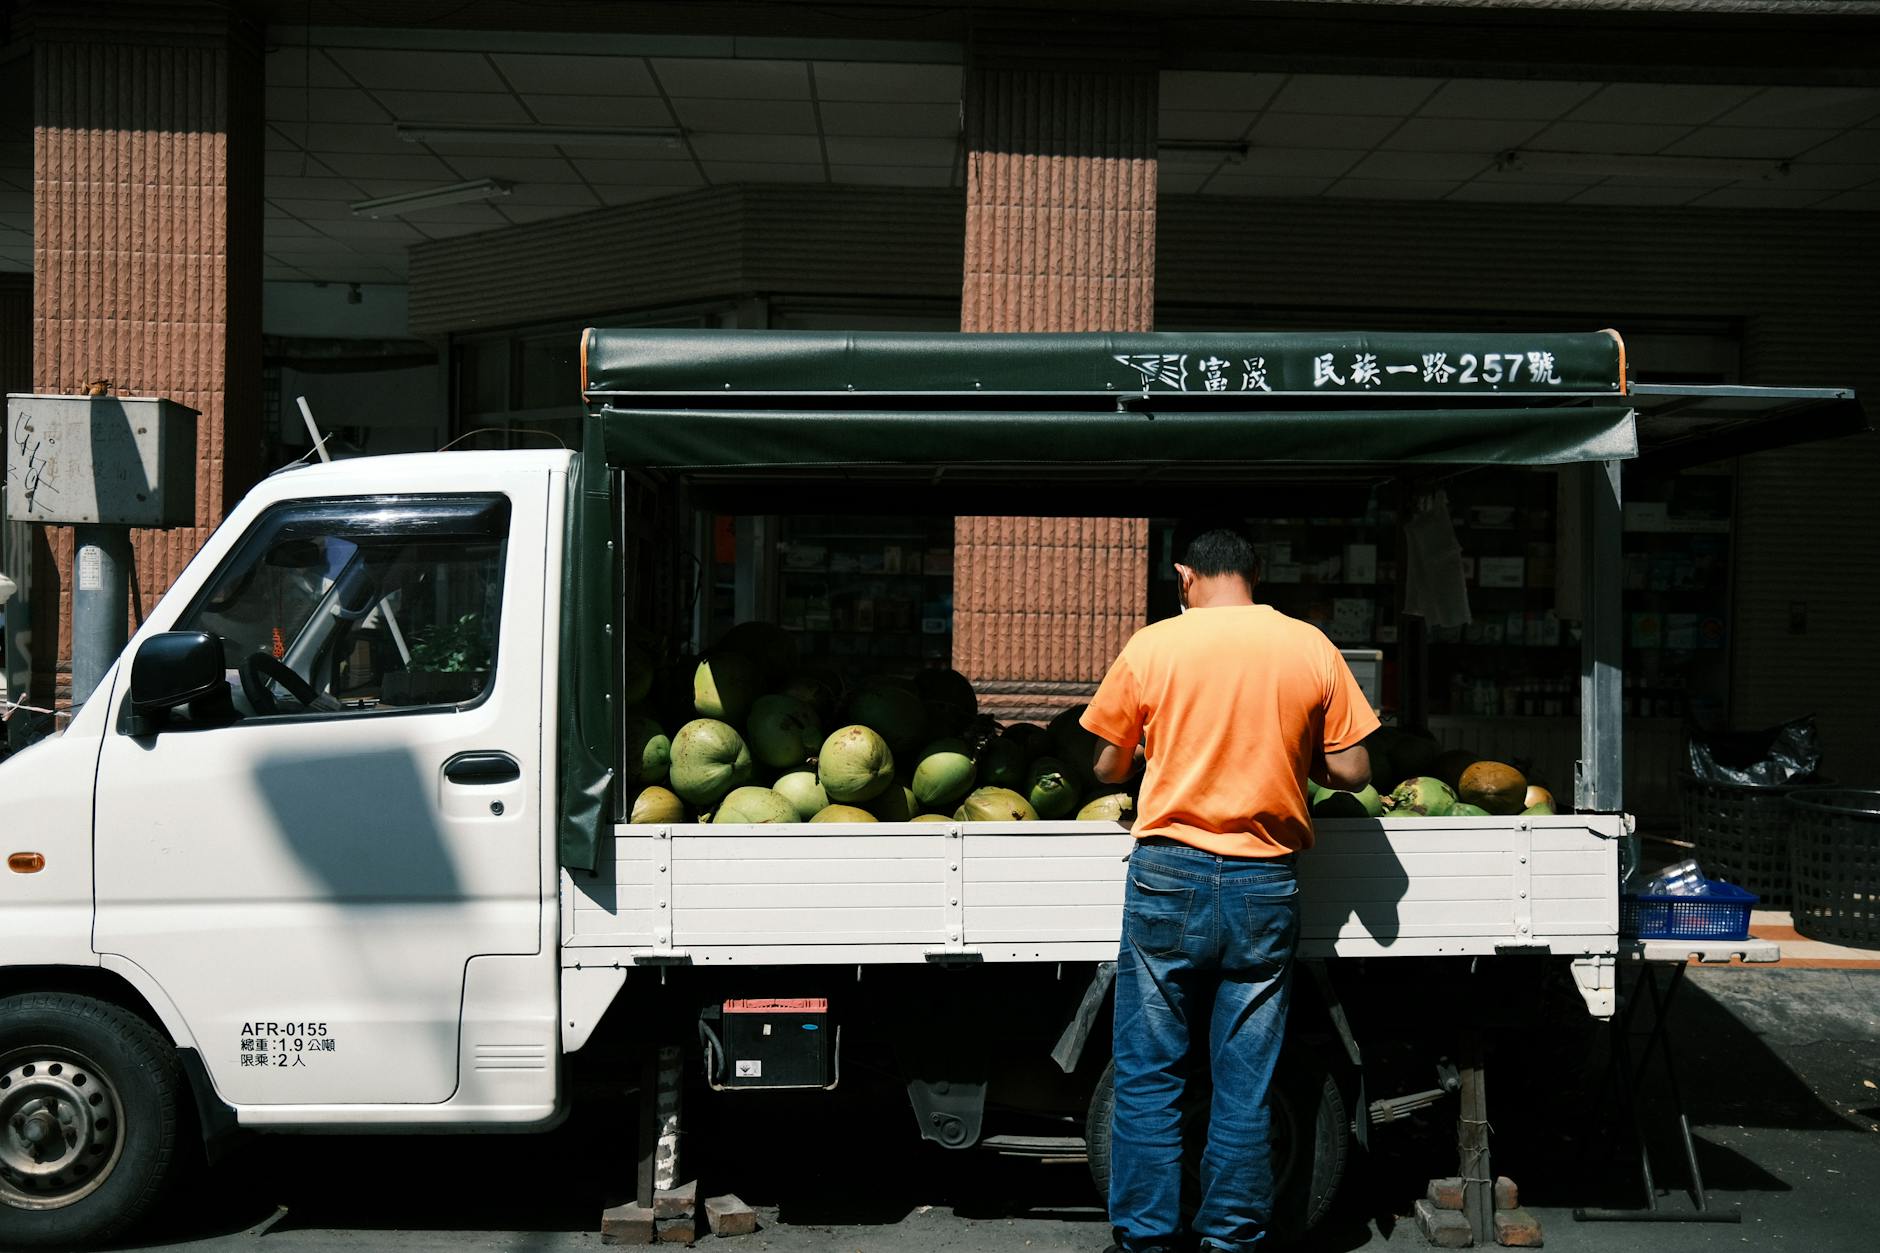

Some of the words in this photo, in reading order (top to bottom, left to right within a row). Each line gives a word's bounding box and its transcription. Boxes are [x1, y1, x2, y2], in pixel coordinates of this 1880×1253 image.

[1313, 351, 1561, 387] 民族一路257號
[241, 1022, 327, 1036] AFR-0155
